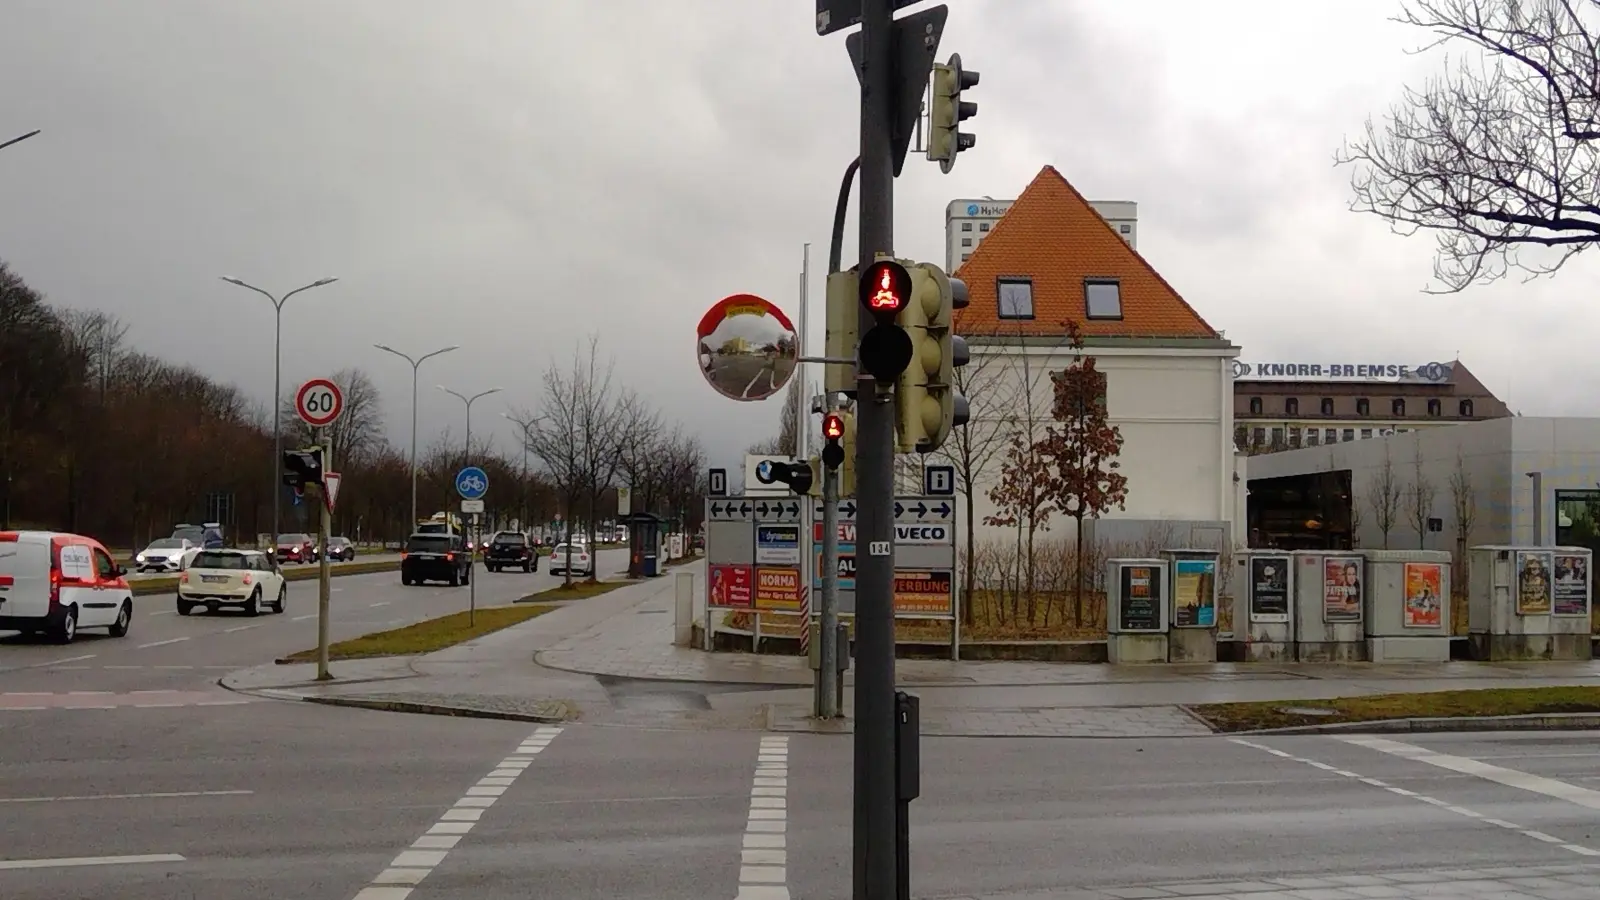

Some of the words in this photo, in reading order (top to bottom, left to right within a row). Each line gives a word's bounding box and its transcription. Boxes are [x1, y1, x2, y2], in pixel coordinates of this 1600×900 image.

[1257, 363, 1409, 378] KNORR-BREMSE
[306, 392, 333, 412] 60
[871, 544, 889, 554] 134
[760, 575, 795, 587] NORMA
